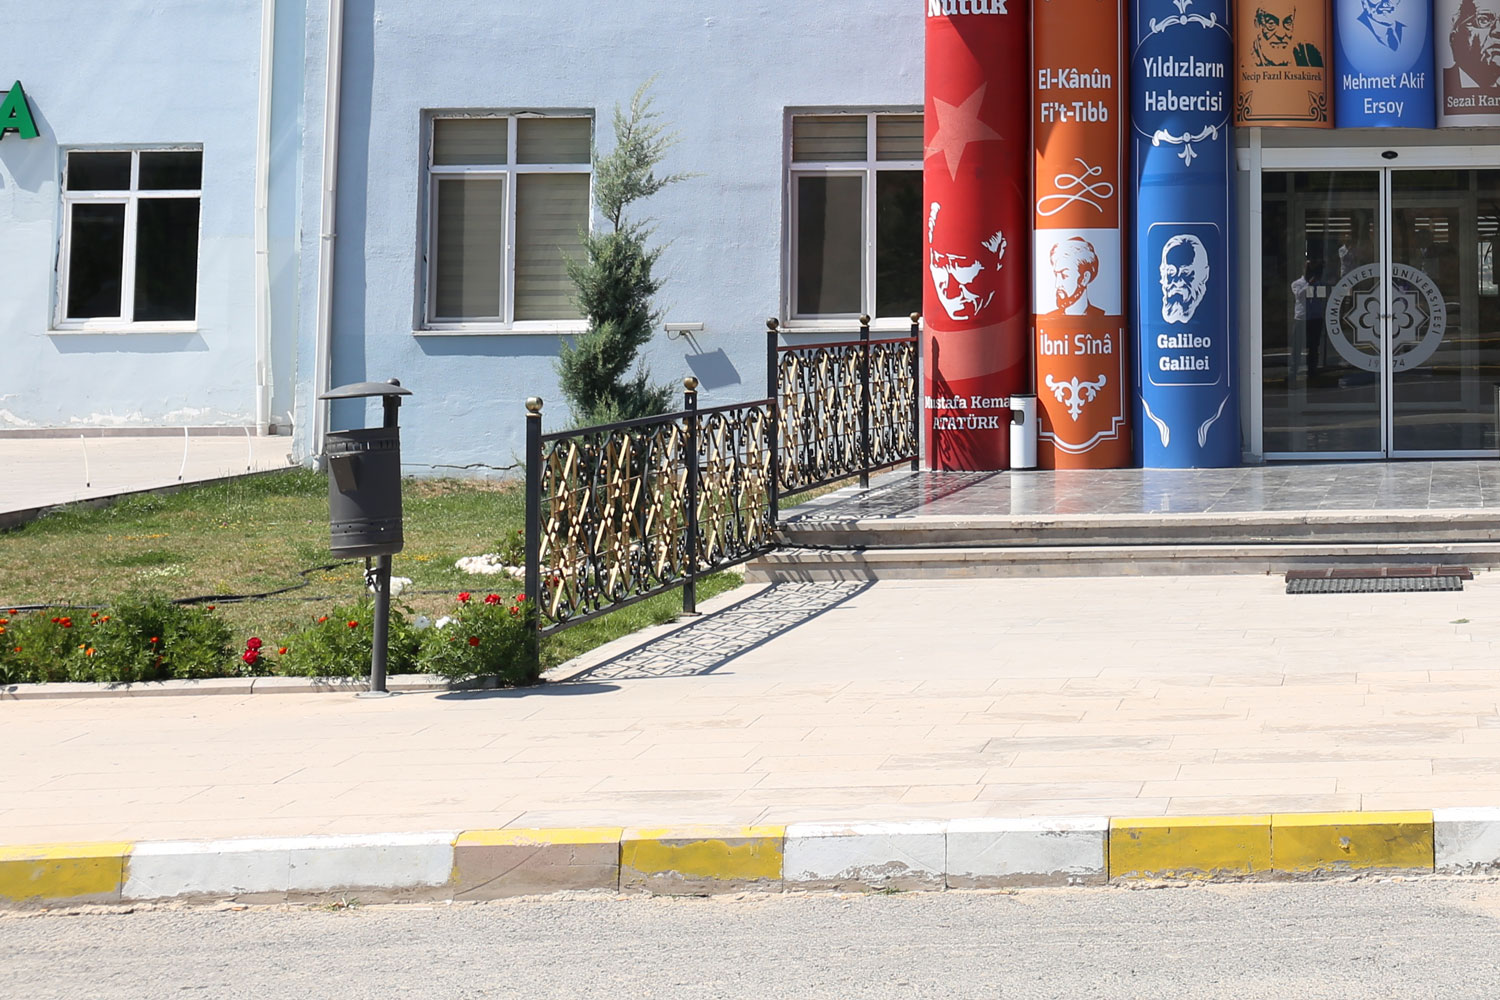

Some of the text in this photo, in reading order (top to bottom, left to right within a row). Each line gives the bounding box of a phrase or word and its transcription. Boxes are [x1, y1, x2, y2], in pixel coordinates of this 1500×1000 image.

[1143, 56, 1225, 80] Yıldızların
[1242, 70, 1322, 83] Necip Fazıl Kısakürek
[1038, 69, 1112, 90] El-Kânûn
[1343, 72, 1425, 90] Mehmet Akif
[1145, 90, 1223, 113] Habercisi
[1364, 97, 1404, 118] Ersoy
[1447, 94, 1476, 108] Sezai
[1040, 329, 1112, 355] İbni Sînâ
[1157, 333, 1211, 349] Galileo
[1159, 355, 1210, 371] Galilei
[924, 395, 1010, 409] Mustafa Kema
[933, 413, 999, 430] ATATÜRK
